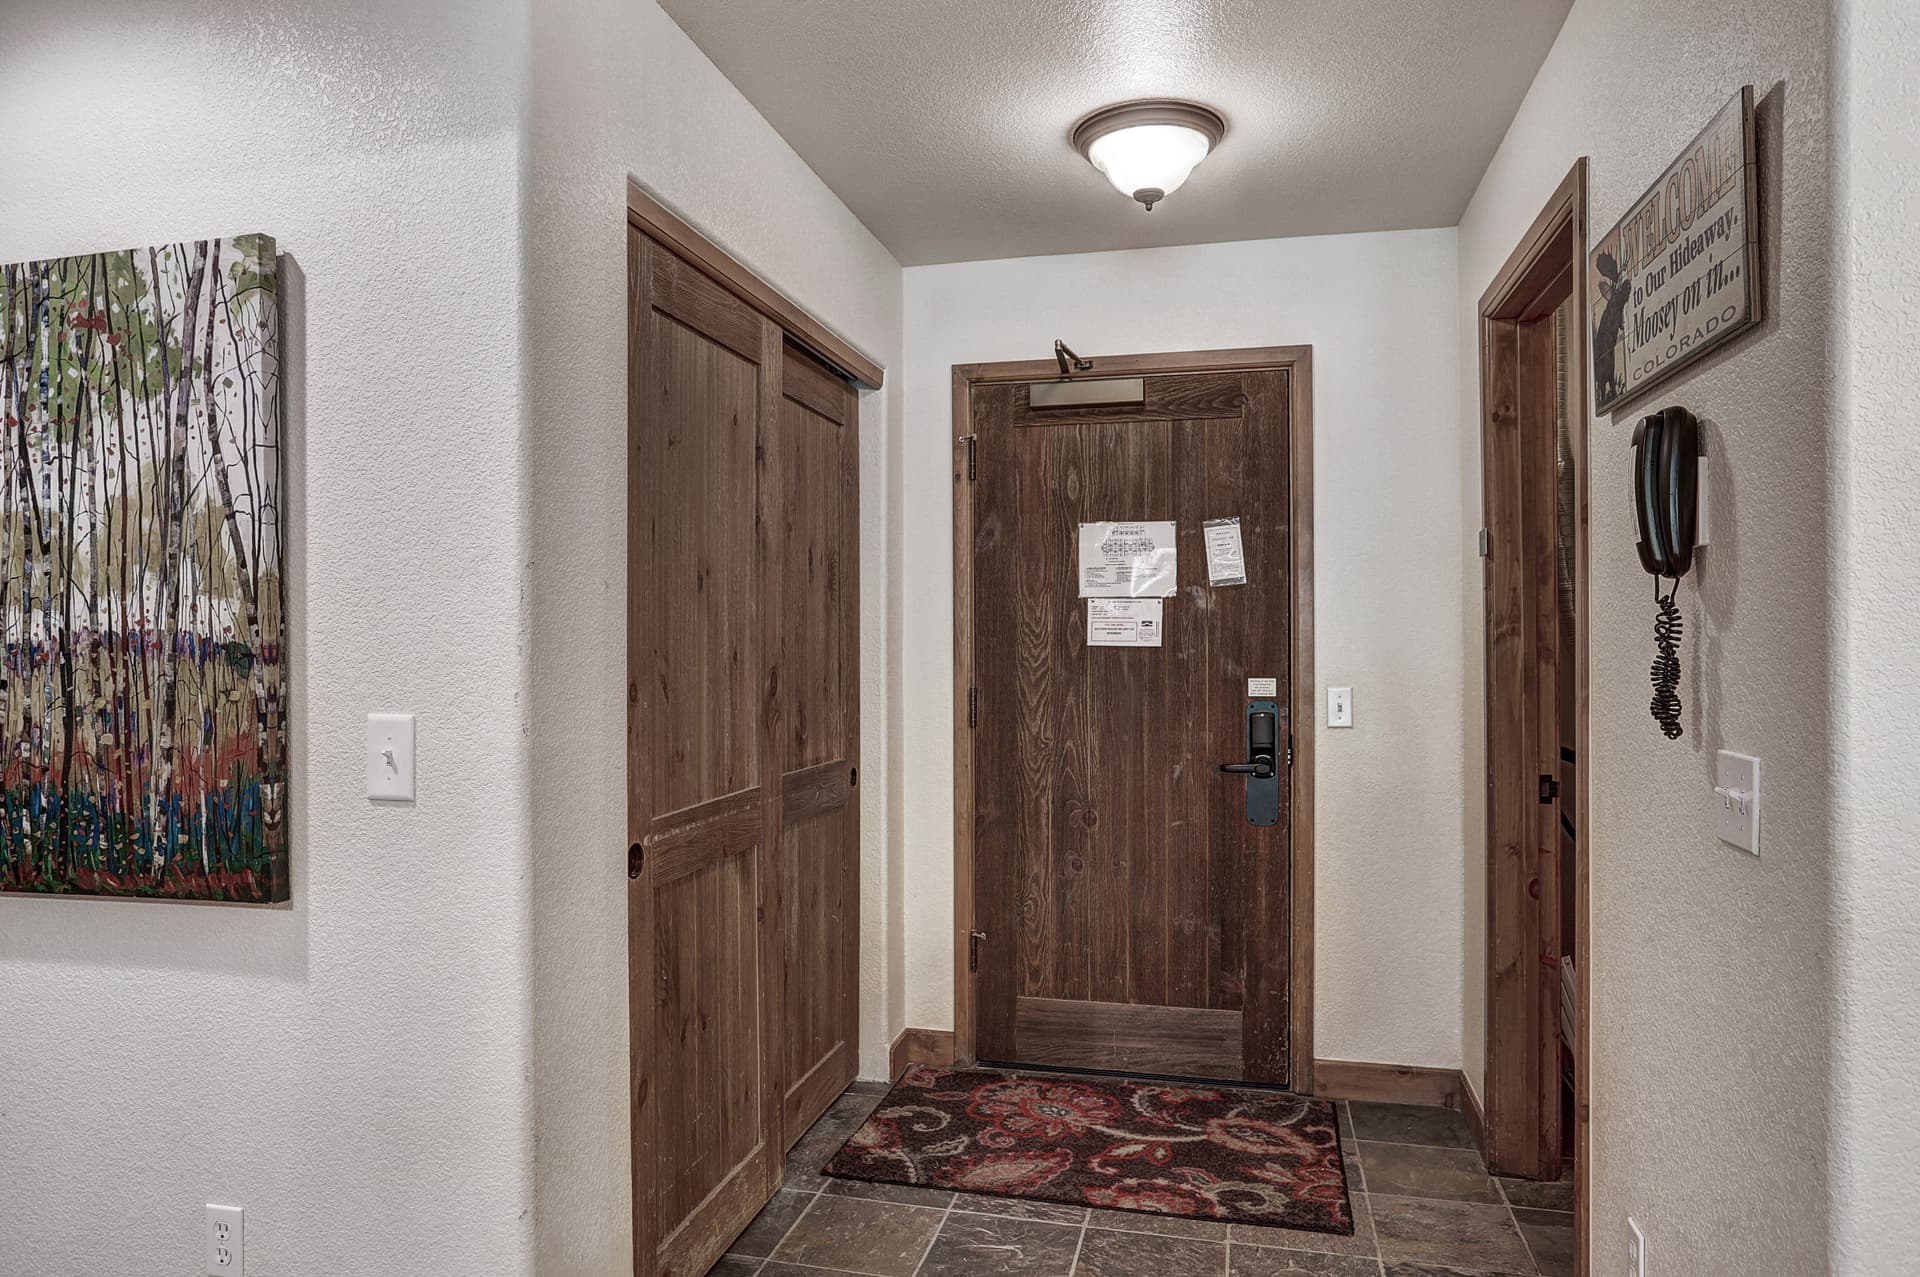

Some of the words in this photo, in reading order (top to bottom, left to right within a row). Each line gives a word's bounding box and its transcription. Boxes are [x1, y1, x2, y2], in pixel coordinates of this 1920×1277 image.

[1623, 125, 1736, 282] WELCOME
[1631, 296, 1679, 354] Moosey
[1682, 277, 1702, 315] on
[1707, 253, 1740, 299] in...
[1633, 286, 1643, 308] to
[1646, 265, 1667, 298] Our
[1632, 304, 1737, 381] COLORADO
